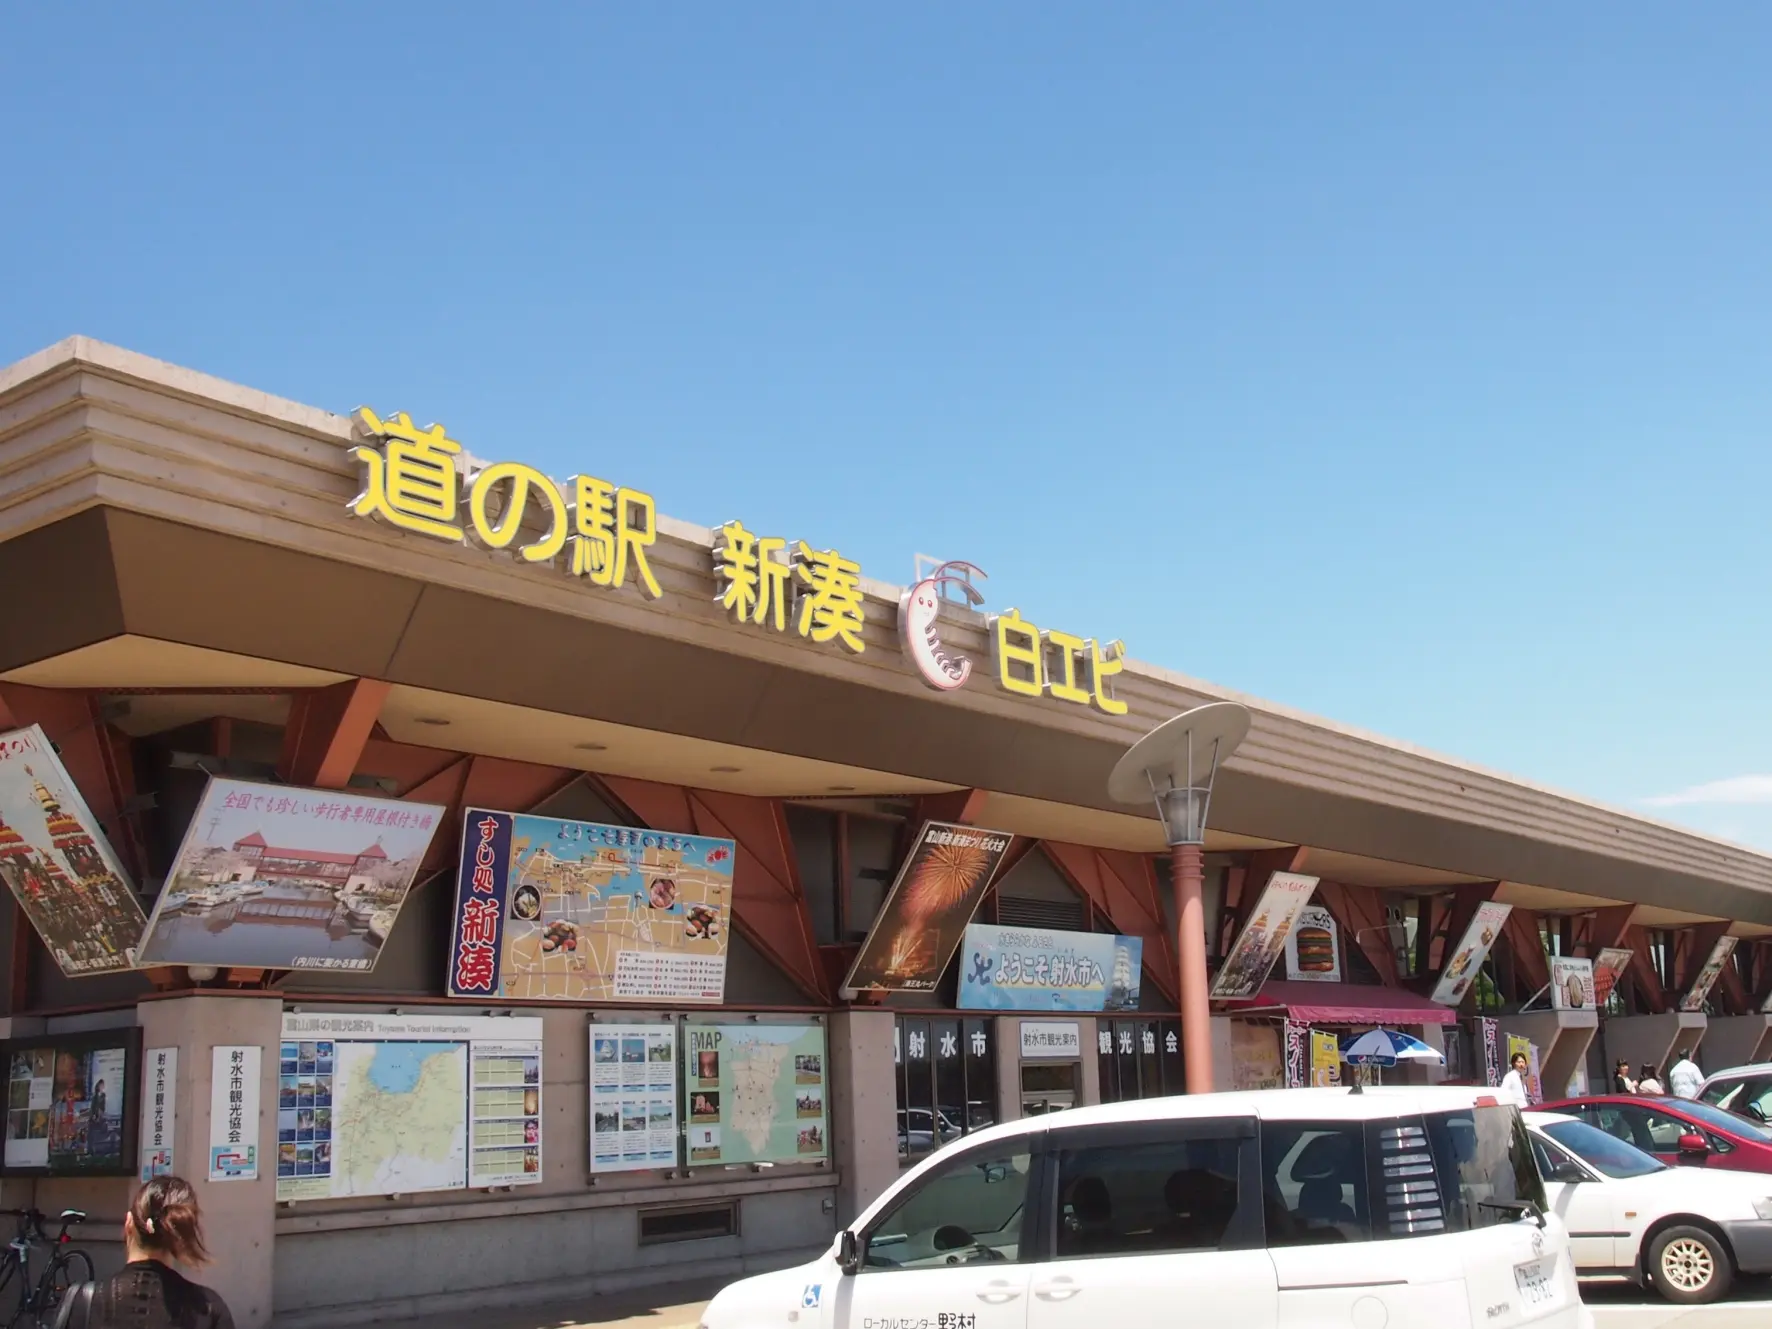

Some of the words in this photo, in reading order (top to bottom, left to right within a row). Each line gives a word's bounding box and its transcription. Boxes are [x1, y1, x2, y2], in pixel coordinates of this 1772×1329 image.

[350, 406, 663, 600] 道の駅
[712, 520, 866, 653] 新湊
[994, 608, 1130, 714] 白エビ
[472, 816, 499, 894] すし処
[456, 898, 500, 991] 新湊
[691, 1031, 722, 1049] MAP
[1023, 1033, 1077, 1046] 射水市観光案内
[1098, 1030, 1178, 1055] 観光協会
[154, 1052, 166, 1145] 射水市観光協会
[228, 1051, 243, 1143] 射水市観光協会
